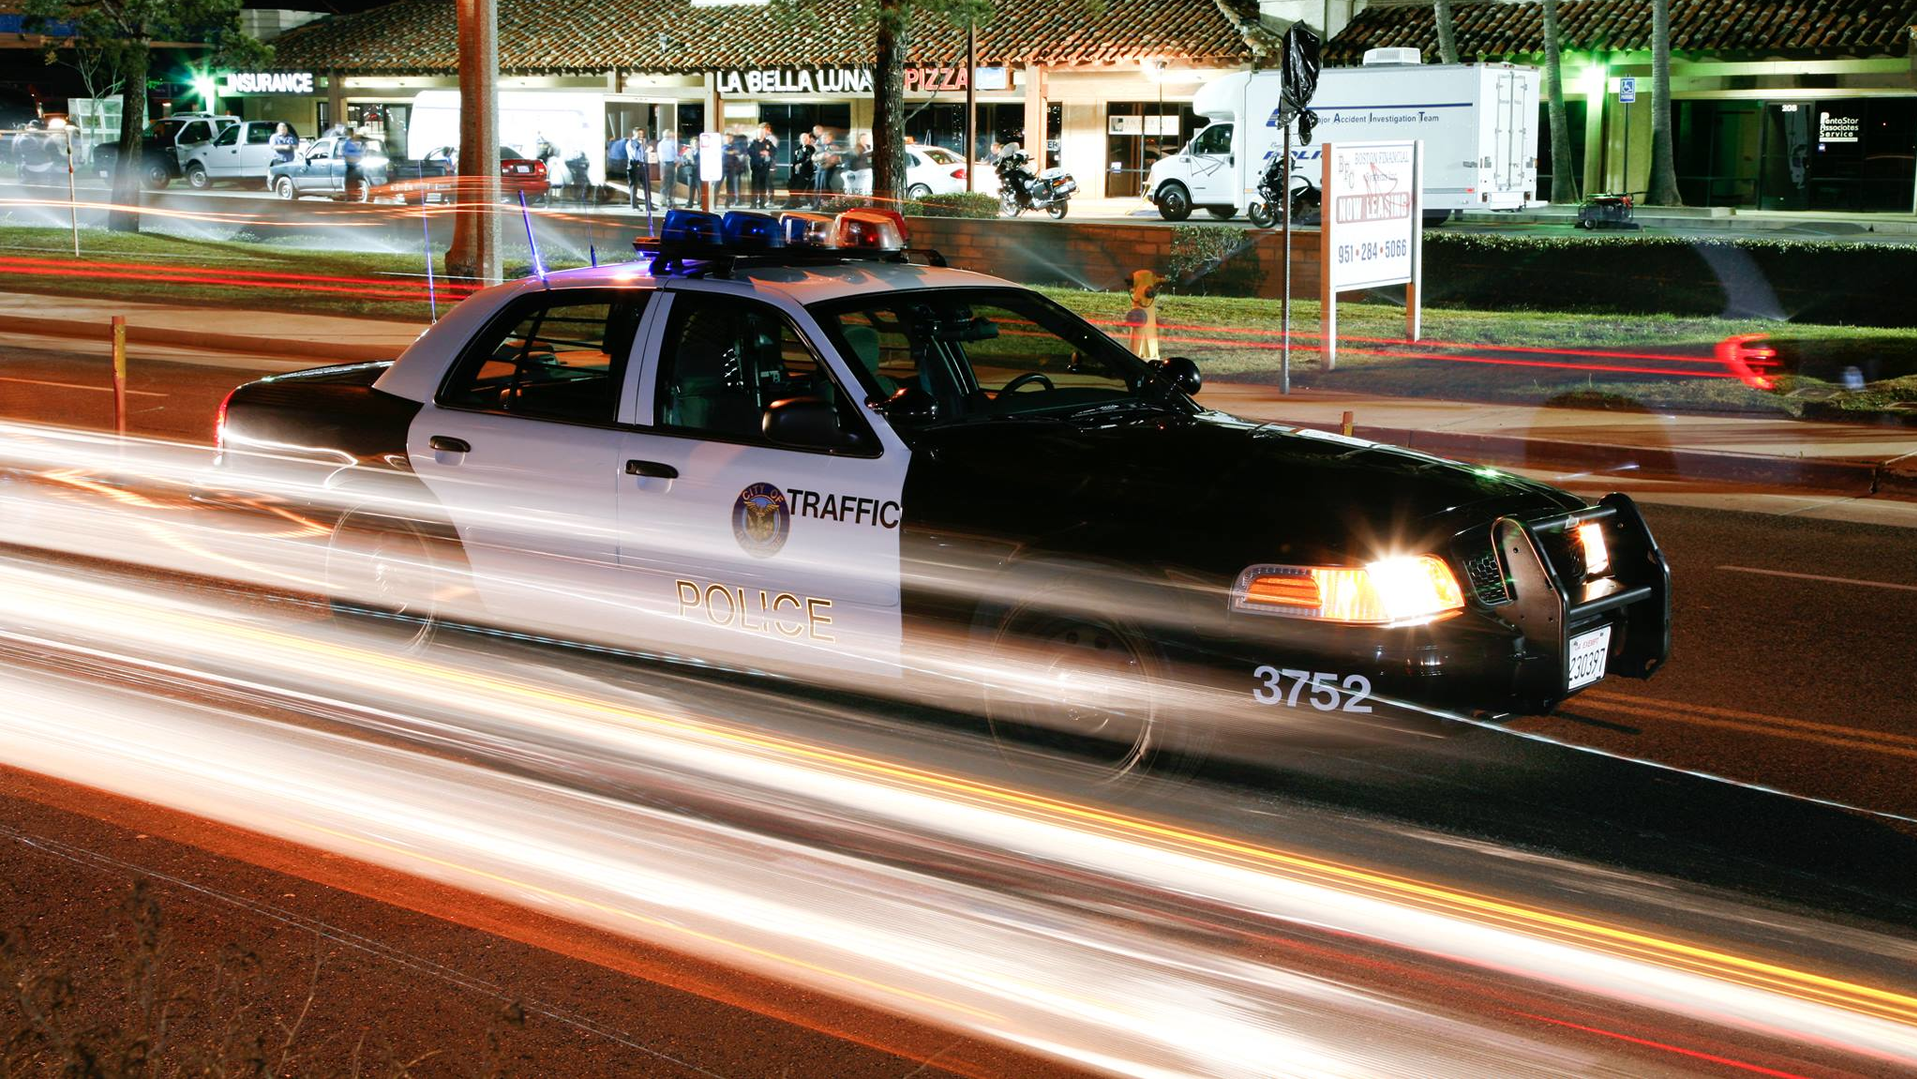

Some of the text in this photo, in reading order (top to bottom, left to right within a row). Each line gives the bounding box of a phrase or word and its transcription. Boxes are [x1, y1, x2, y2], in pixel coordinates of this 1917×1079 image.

[227, 73, 313, 92] INSURANCE
[717, 68, 967, 92] LA BELLA LUNA PIZZA
[1333, 113, 1366, 124] Accident
[1369, 112, 1416, 123] Investigation
[1418, 111, 1439, 122] Team
[1782, 104, 1798, 112] 208
[1355, 151, 1409, 165] BOSTON FINANCIAL
[1339, 194, 1407, 221] NOW LEASING
[1339, 239, 1407, 264] 951 284 5066
[742, 483, 784, 503] CITY OF
[787, 488, 900, 529] TRAFFIC
[675, 579, 836, 643] POLICE
[1569, 648, 1606, 681] 230397
[1252, 665, 1373, 713] 3752
